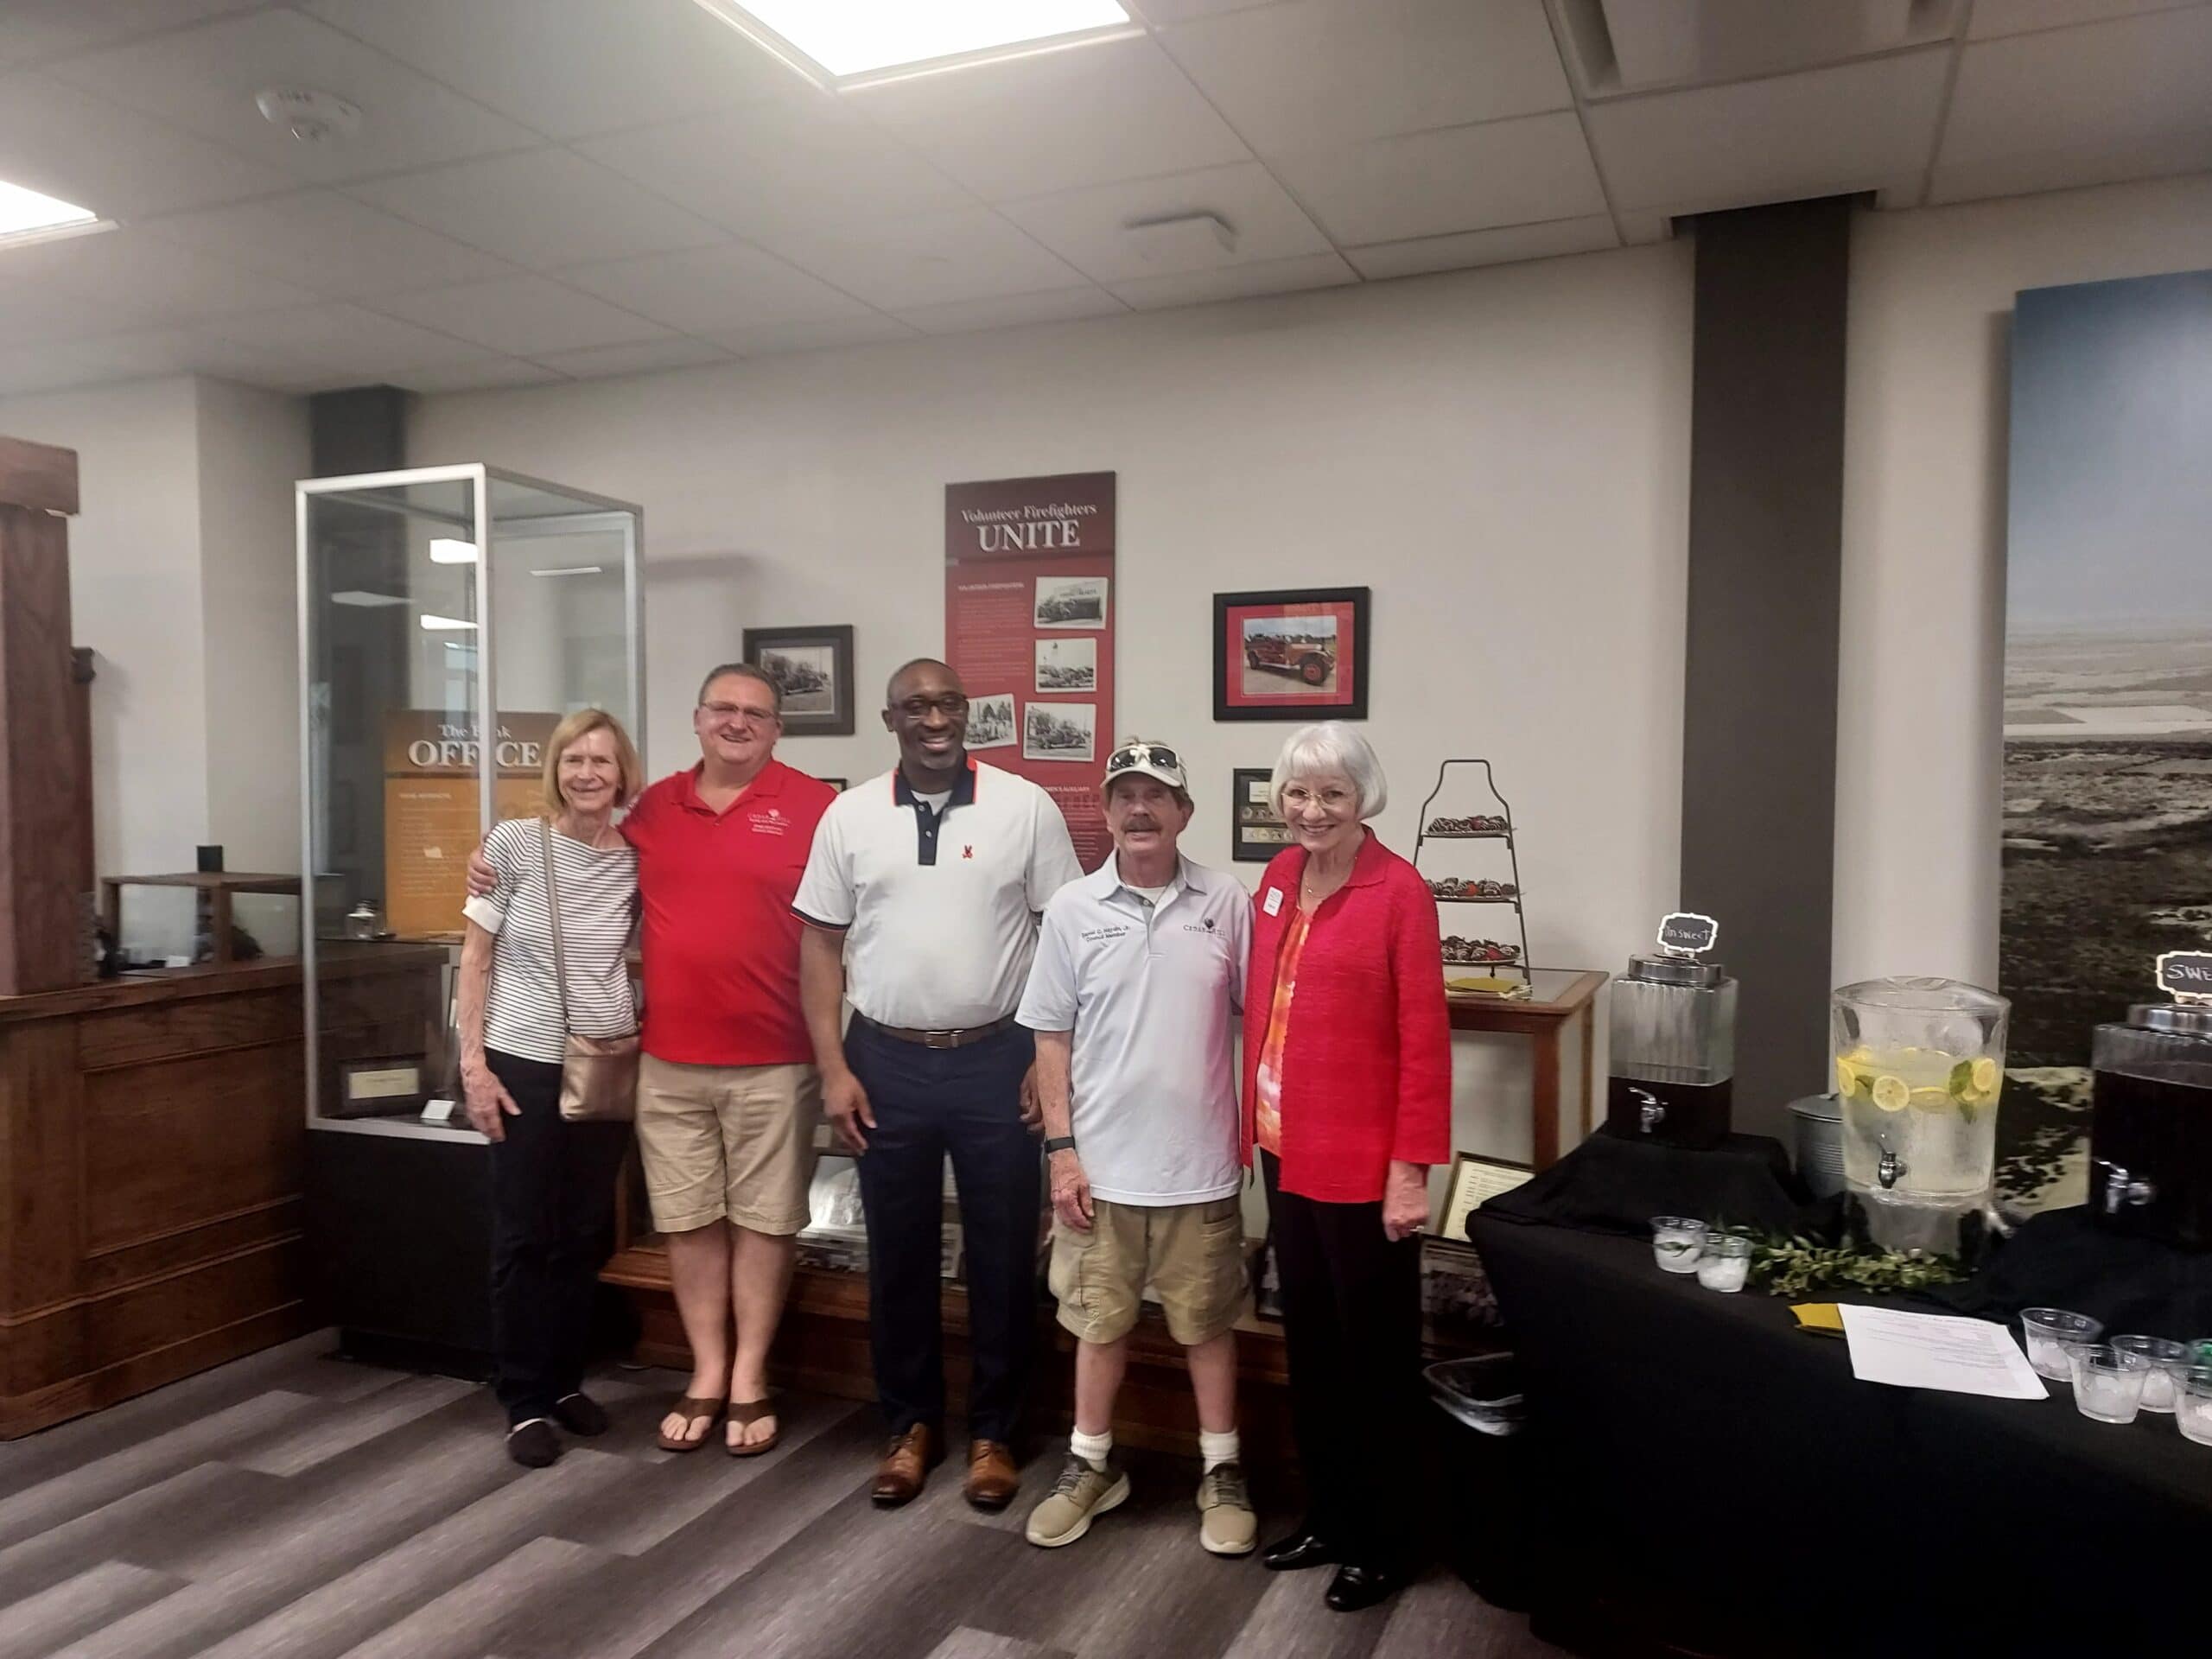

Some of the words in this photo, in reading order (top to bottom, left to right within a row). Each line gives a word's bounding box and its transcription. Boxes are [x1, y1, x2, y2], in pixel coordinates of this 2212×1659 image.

[961, 509, 1021, 524] Volunteer
[1023, 502, 1098, 520] Firefighters
[976, 519, 1081, 552] UNITE
[437, 723, 468, 738] The
[408, 740, 542, 767] OFFCE
